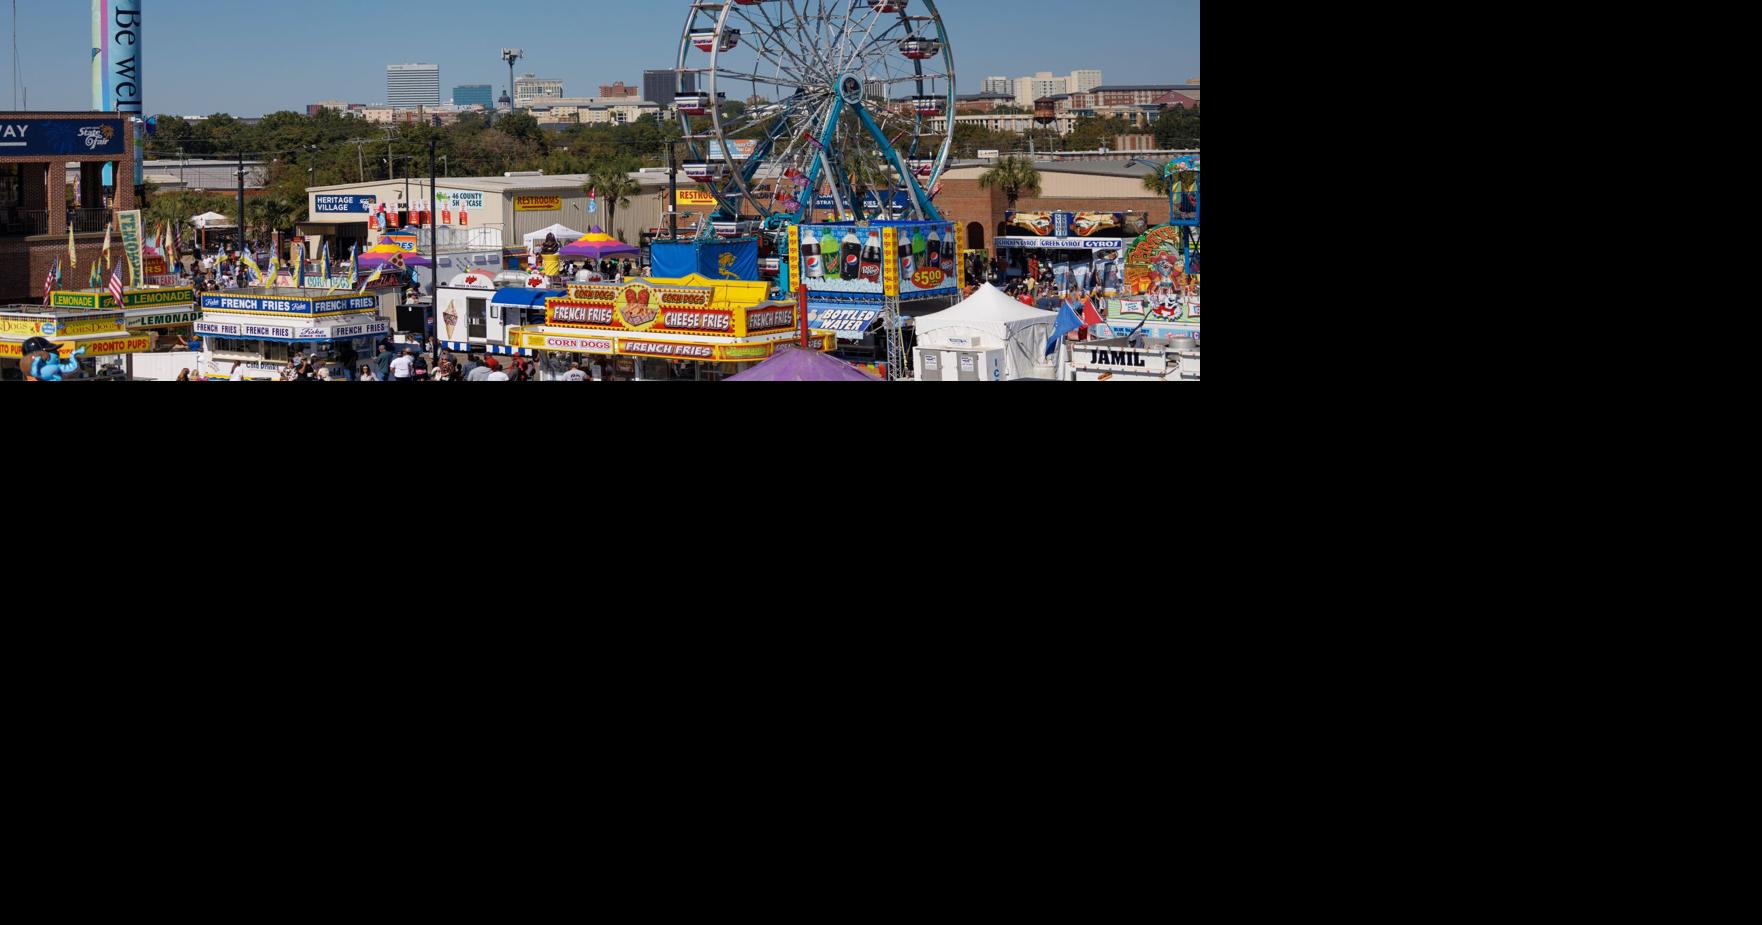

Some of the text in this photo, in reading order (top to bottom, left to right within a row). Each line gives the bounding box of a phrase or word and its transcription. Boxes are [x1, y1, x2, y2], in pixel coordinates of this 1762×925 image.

[115, 6, 141, 46] Be
[0, 124, 28, 138] AY
[77, 126, 102, 138] State
[518, 196, 560, 204] RESTROOMS
[134, 291, 191, 303] LEMONADE
[574, 289, 616, 299] CORN DOGS
[662, 293, 705, 305] CORN DOGS
[54, 296, 92, 306] LEMONADE
[222, 298, 257, 309] FRENCH
[262, 300, 290, 311] FRIES
[315, 298, 374, 312] FRENCH FRIES
[554, 306, 612, 322] FRENCH FRIES
[750, 310, 792, 328] FRENCH FRIES
[823, 309, 876, 320] BOTTLED
[665, 313, 730, 330] CHEESE FRIES
[820, 320, 863, 330] WATER
[197, 324, 236, 334] FRENCH FRIES
[246, 326, 288, 336] FRENCH FRIES
[336, 324, 384, 336] FRENCH FRIES
[92, 338, 148, 352] PRONTO PUPS
[548, 338, 576, 346] CORN
[581, 340, 610, 348] DOGS
[625, 343, 712, 356] FRENCH FRIES
[1090, 350, 1145, 366] JAMIL
